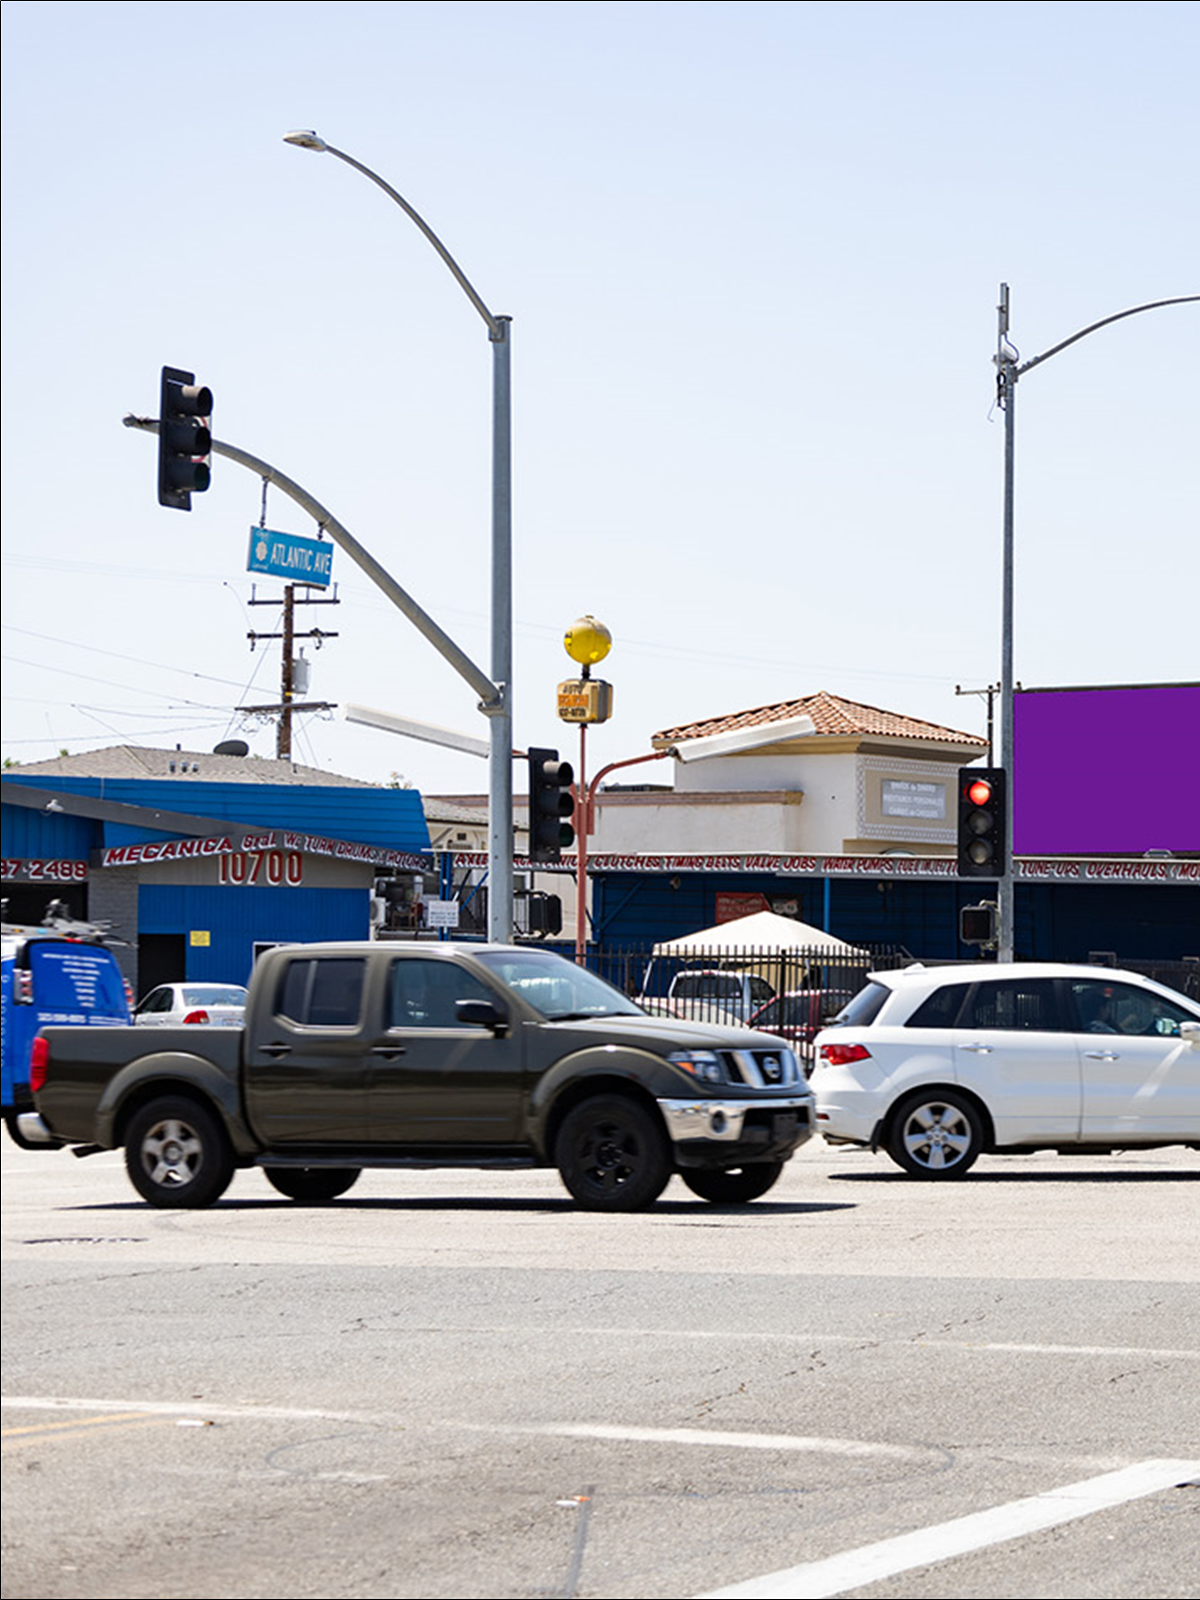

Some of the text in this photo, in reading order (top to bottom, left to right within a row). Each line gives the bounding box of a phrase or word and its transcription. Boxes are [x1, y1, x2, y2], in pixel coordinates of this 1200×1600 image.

[270, 543, 332, 575] ATLANTIC AVE
[102, 837, 234, 866] MECANICA
[594, 855, 661, 870] CLUTCHES
[703, 856, 740, 870] BELTS
[743, 856, 780, 870] VALVE
[782, 856, 817, 871] JOBS
[855, 858, 893, 874] PUMPS
[218, 850, 303, 886] 10700
